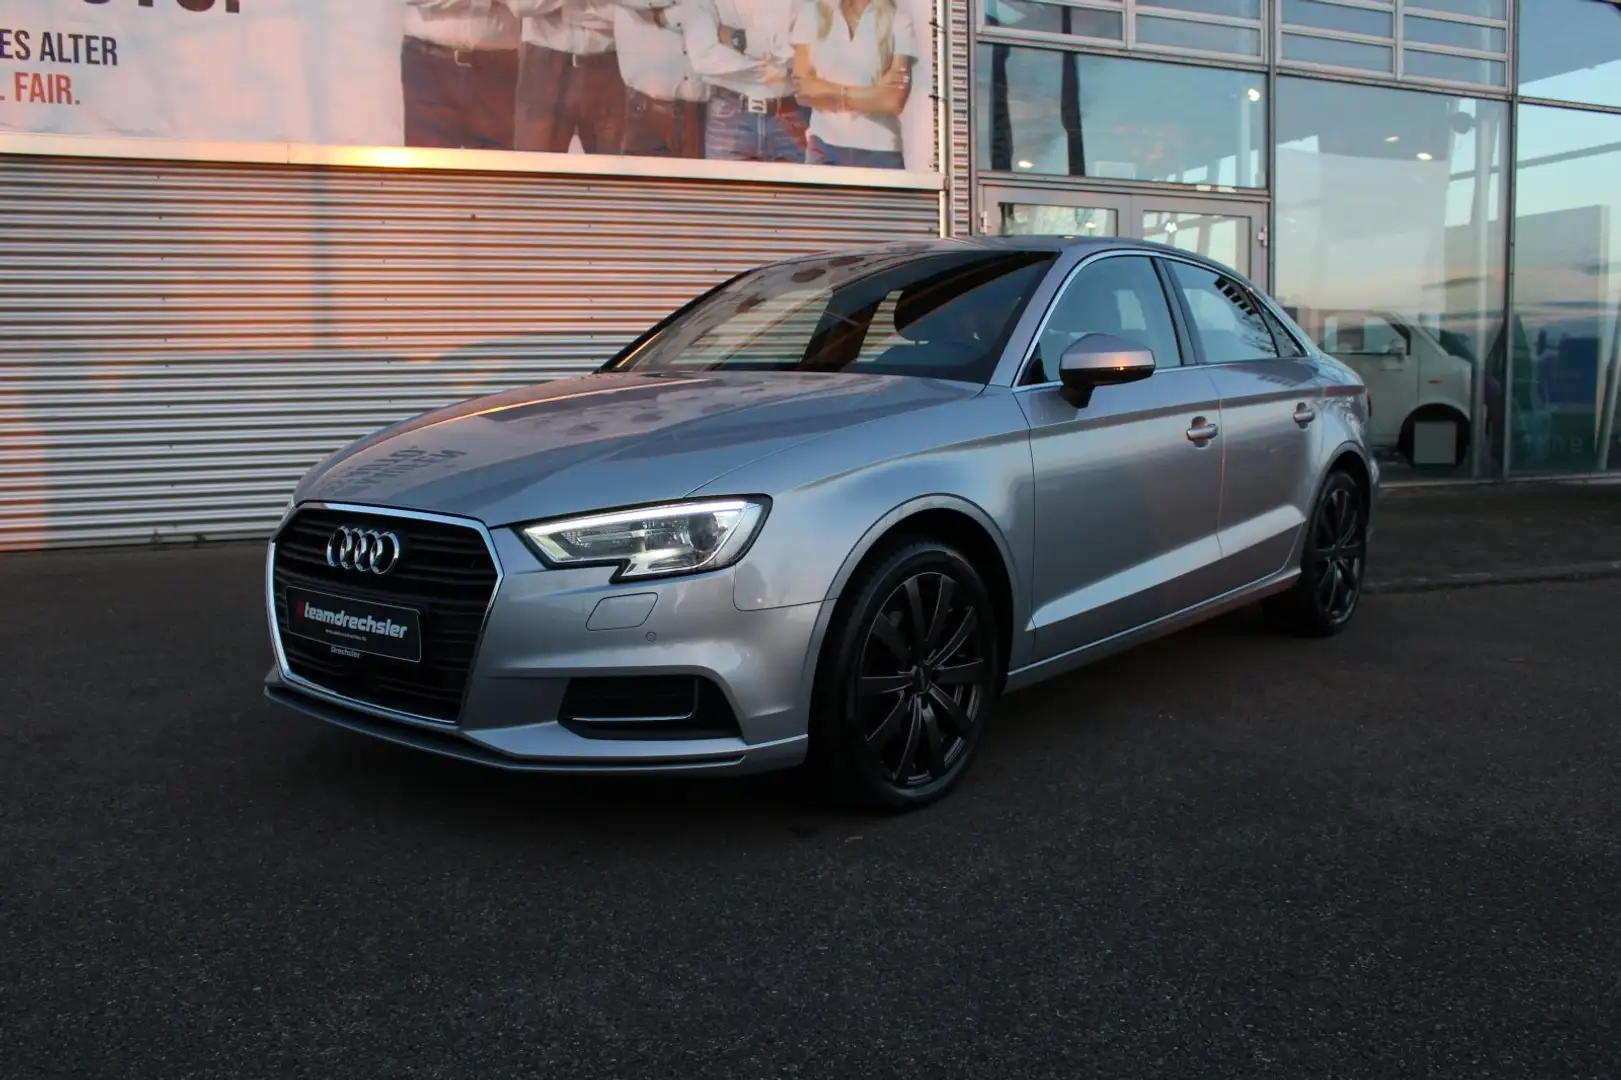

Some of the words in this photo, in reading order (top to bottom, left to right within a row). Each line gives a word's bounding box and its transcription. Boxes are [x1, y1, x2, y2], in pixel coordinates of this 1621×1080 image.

[40, 32, 118, 66] ALTER
[14, 72, 81, 105] FAIR.
[303, 601, 408, 639] teamdrechsler
